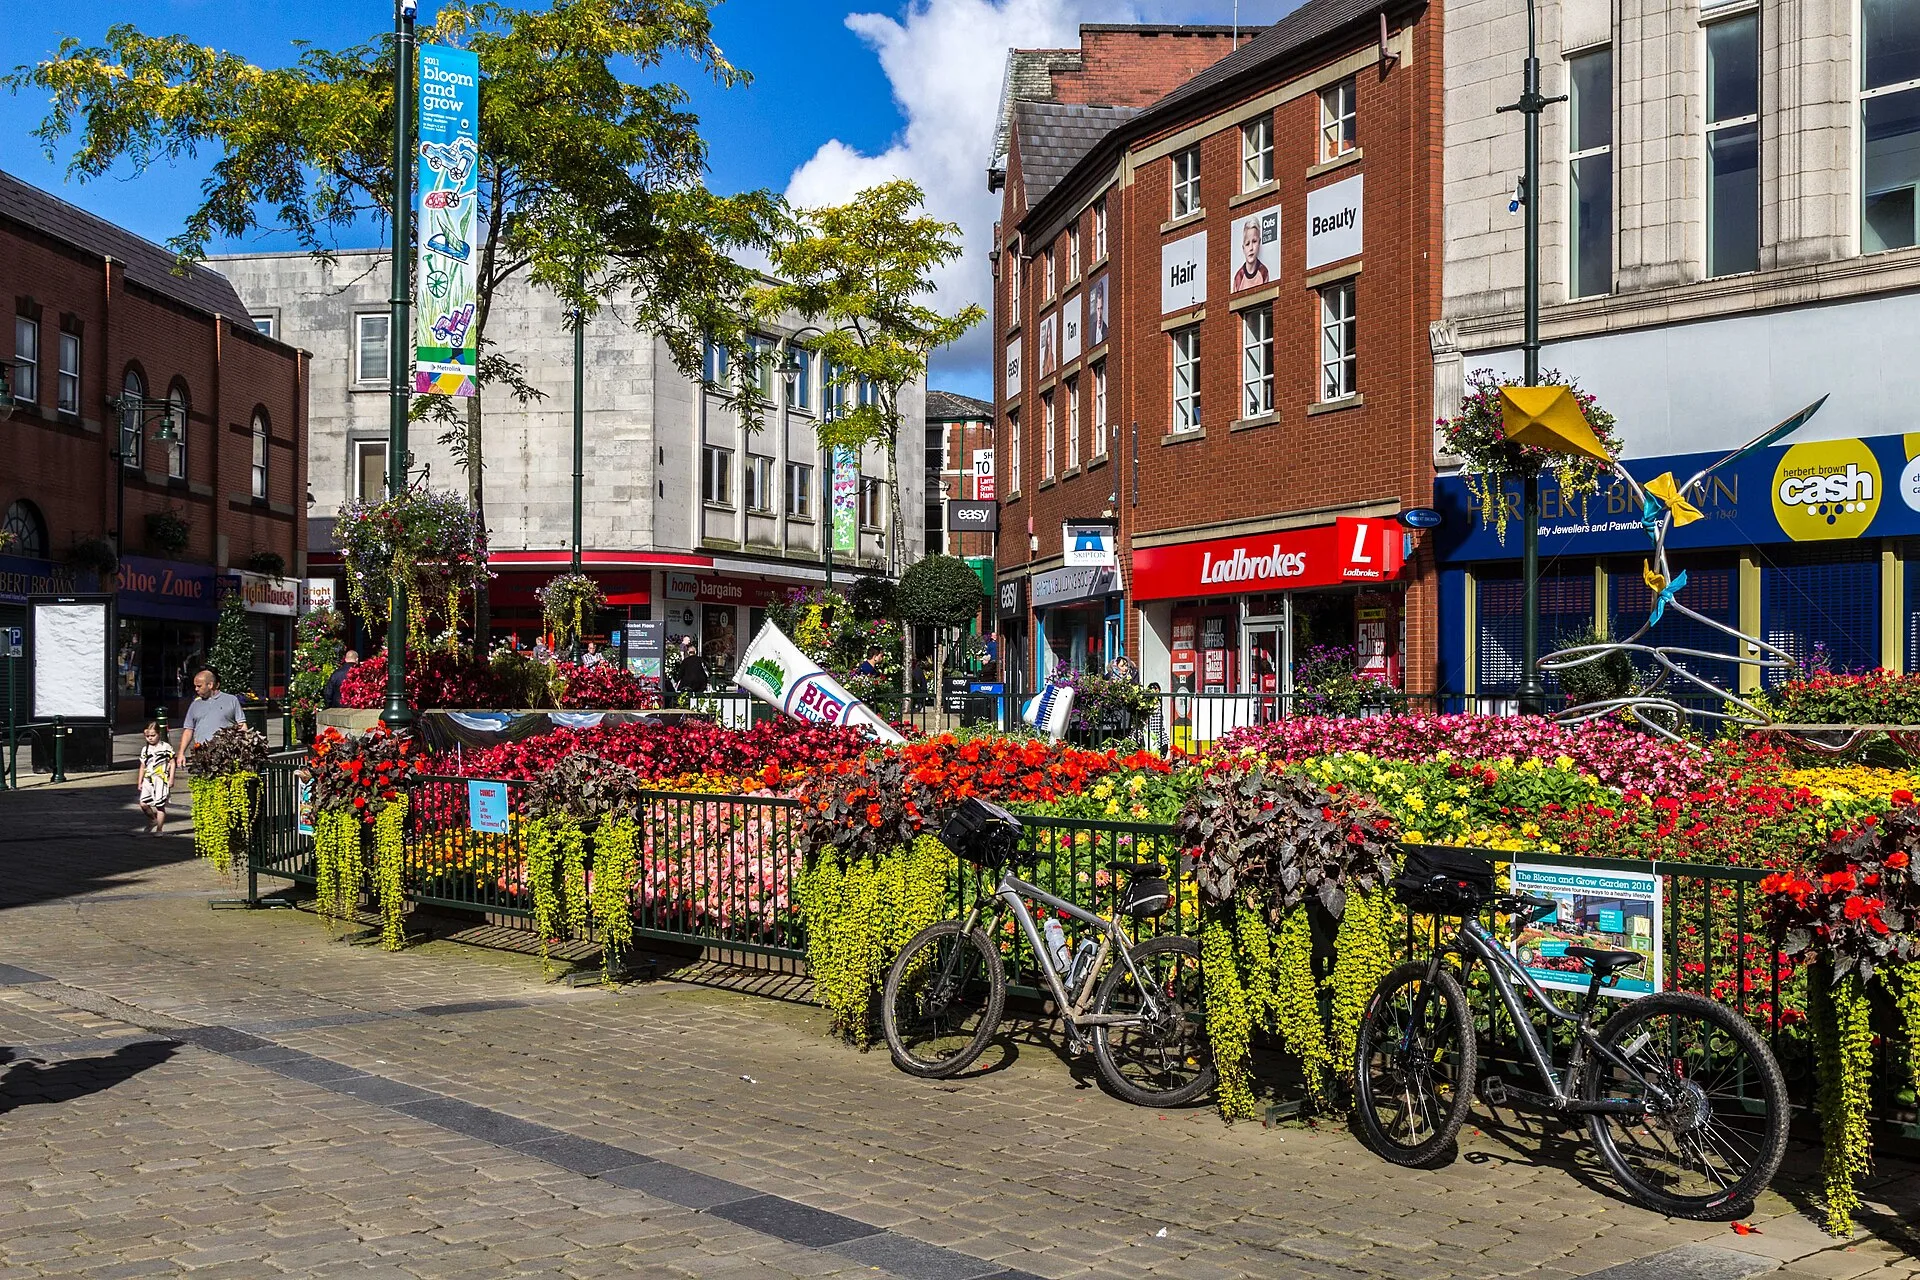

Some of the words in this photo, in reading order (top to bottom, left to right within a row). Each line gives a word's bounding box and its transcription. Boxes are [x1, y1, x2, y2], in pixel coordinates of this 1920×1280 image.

[424, 57, 439, 66] 2011
[423, 65, 473, 87] bloom
[423, 83, 456, 98] and
[423, 96, 464, 112] grow
[1262, 218, 1276, 229] Cuts
[1312, 207, 1357, 237] Beauty
[1170, 260, 1198, 288] Hair
[1067, 321, 1077, 341] Tan
[436, 364, 461, 372] Metrolink
[1008, 356, 1020, 378] easy
[983, 452, 993, 460] SH
[975, 460, 990, 475] TO
[1783, 467, 1816, 478] herbert
[1818, 464, 1846, 475] brown
[1779, 463, 1874, 506] cash
[957, 508, 990, 523] easy
[1715, 508, 1738, 520] 1840
[1552, 523, 1590, 535] Jewellers
[1591, 521, 1608, 533] and
[1351, 524, 1372, 563] L
[1073, 551, 1106, 559] SKIPTON
[1201, 544, 1306, 584] Ladbrokes
[116, 563, 156, 592] Shoe
[161, 569, 202, 598] Zone
[1343, 567, 1380, 578] Ladbrokes
[303, 586, 331, 597] Bright
[671, 577, 697, 592] home
[700, 580, 742, 599] bargains
[1001, 582, 1018, 614] easy
[13, 631, 20, 644] P
[1368, 623, 1385, 638] TEAM
[1204, 633, 1225, 648] OFFERS
[1358, 624, 1368, 655] 5
[764, 662, 779, 676] RHS
[1206, 651, 1212, 672] 5
[752, 666, 780, 692] Greening
[800, 684, 843, 723] BIG
[1517, 872, 1531, 880] The
[1533, 873, 1557, 883] Bloom
[1559, 877, 1574, 885] and
[1576, 877, 1597, 887] Grow
[1600, 879, 1630, 890] Garden
[1632, 882, 1652, 891] 2016
[1543, 885, 1571, 893] incorporates
[1633, 893, 1652, 901] lifestyle
